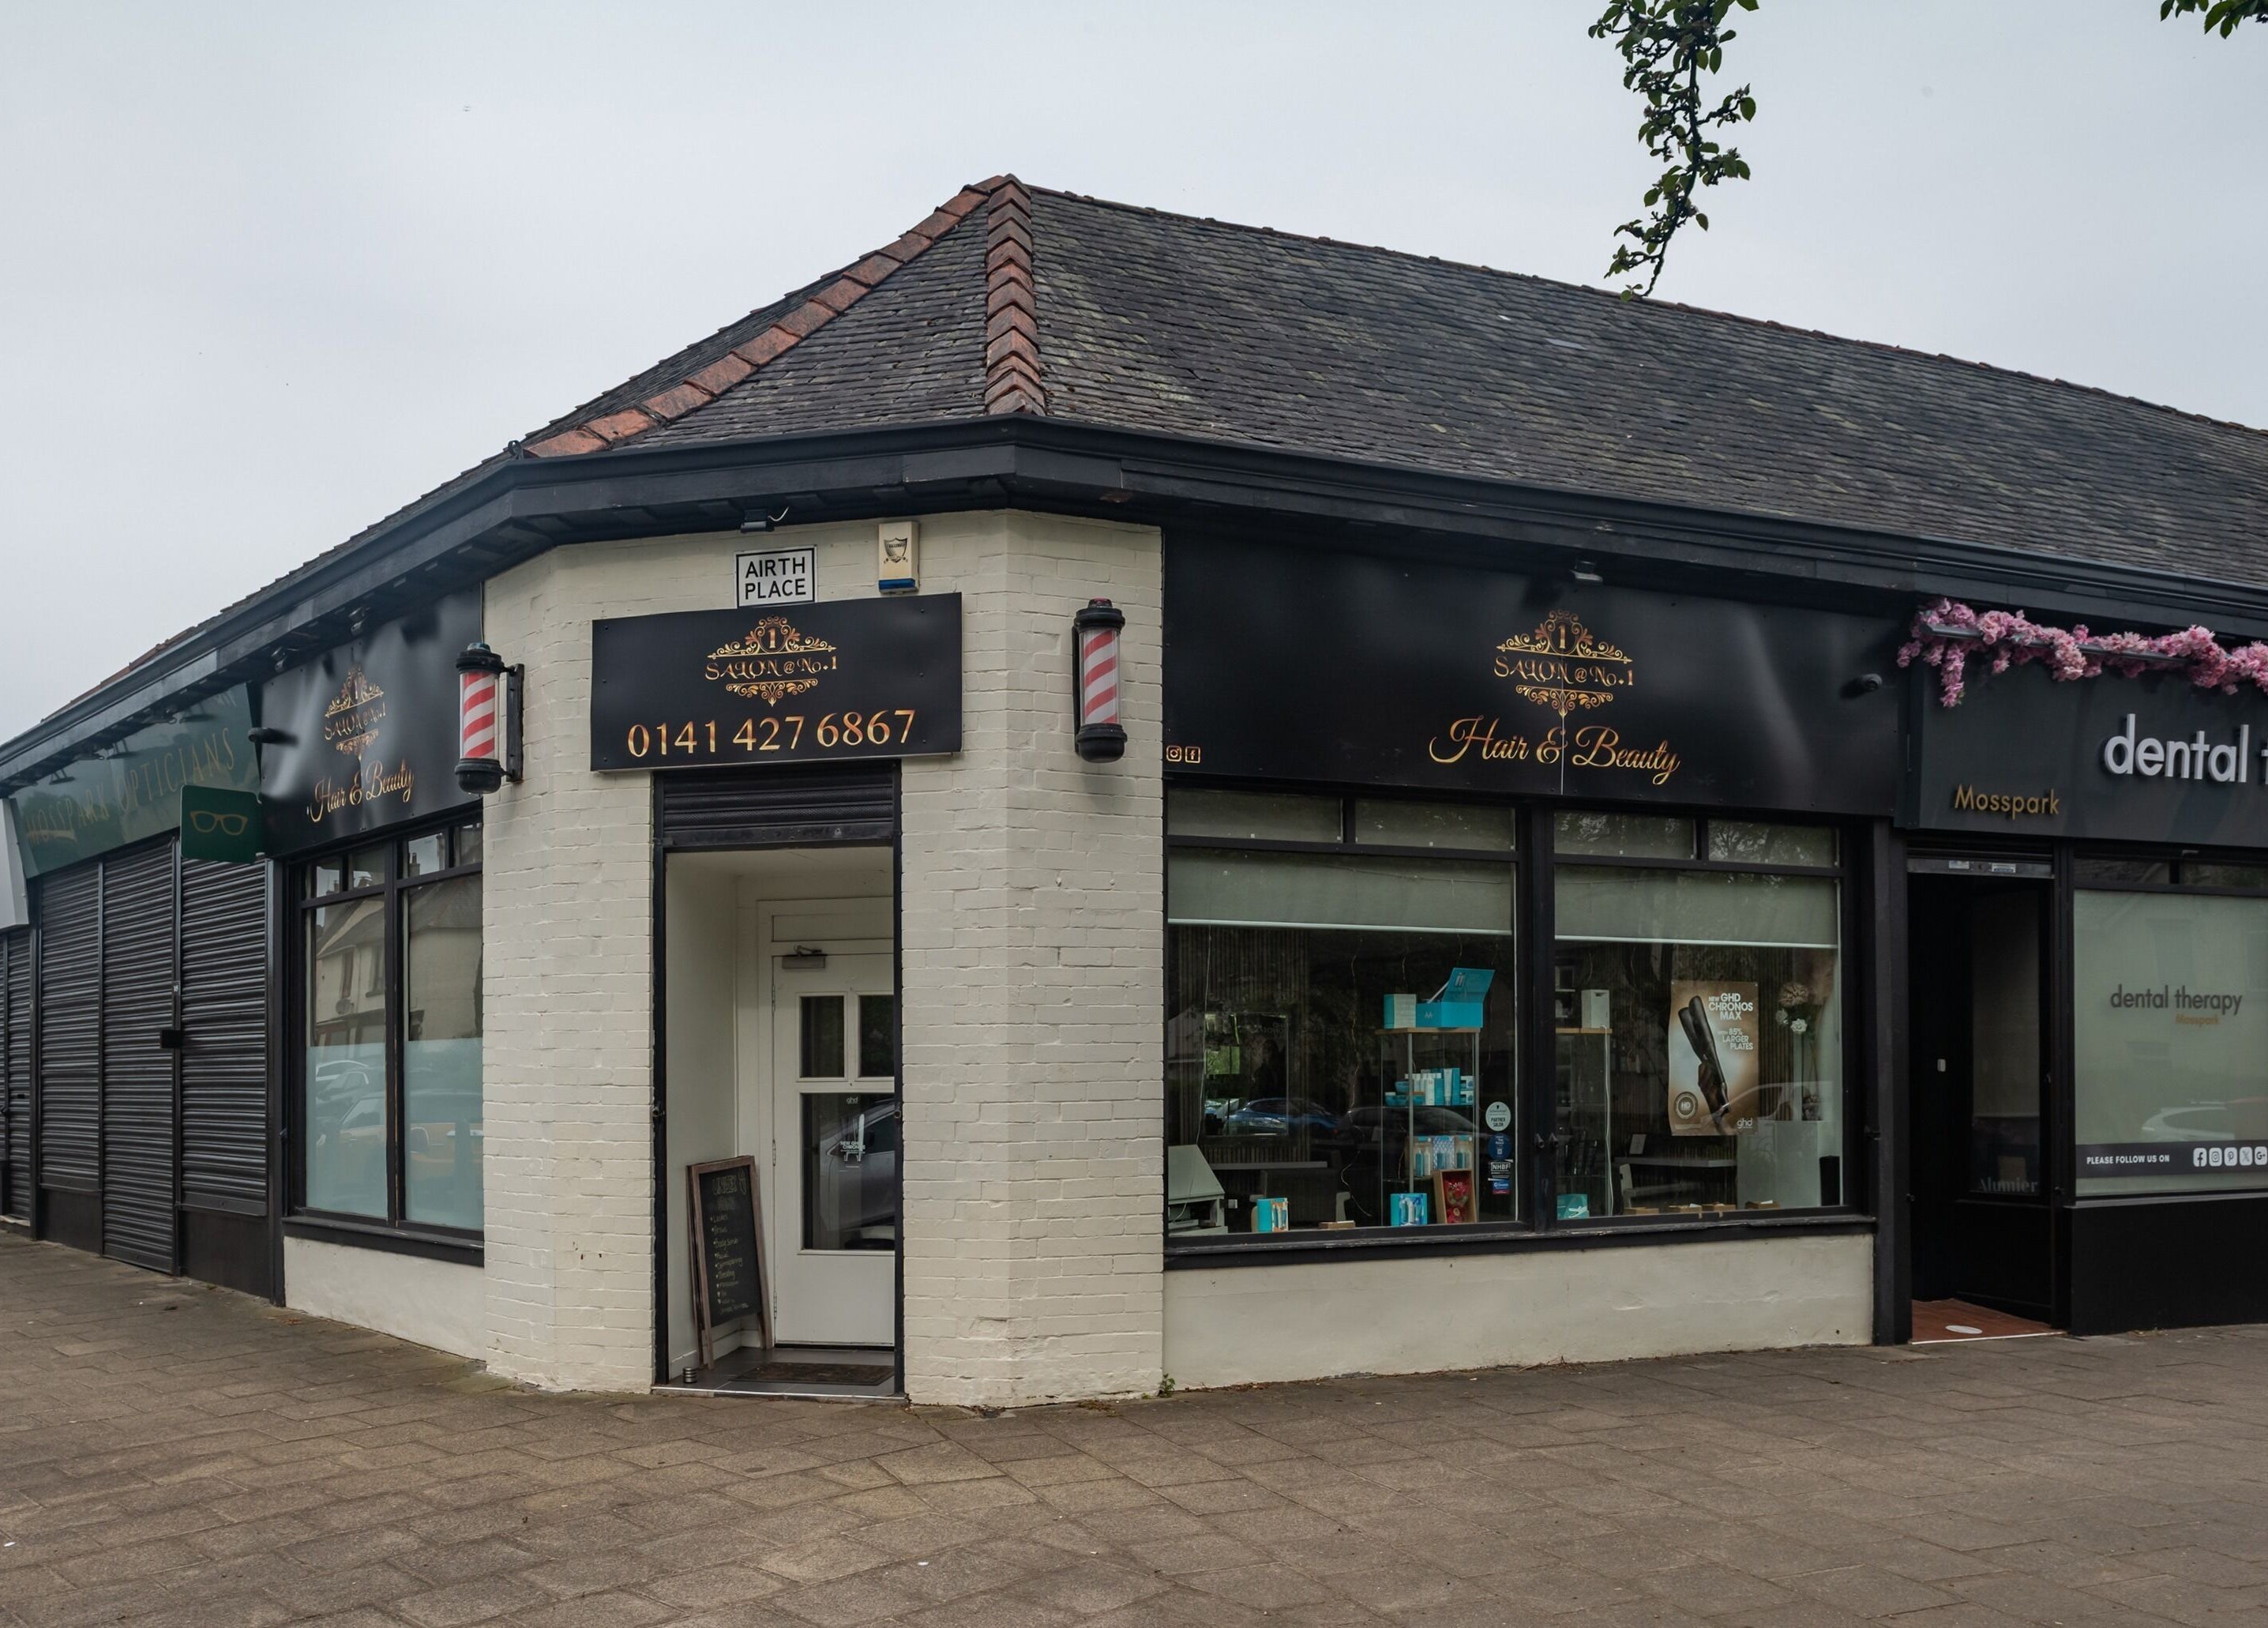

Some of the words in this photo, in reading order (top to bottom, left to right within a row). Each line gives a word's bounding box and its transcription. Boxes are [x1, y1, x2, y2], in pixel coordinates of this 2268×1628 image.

[745, 557, 805, 579] AIRTH
[745, 578, 806, 600] PLACE
[704, 660, 783, 681] SALON
[783, 660, 795, 675] @
[797, 655, 839, 675] No.1
[1493, 655, 1574, 684] SALON
[1575, 667, 1587, 683] @
[1589, 666, 1634, 687] No.1
[627, 720, 715, 758] 0141
[732, 714, 805, 752] 427
[817, 709, 916, 747] 6867
[2103, 712, 2250, 784] dental
[1428, 714, 1530, 765] Hair
[1535, 726, 1568, 765] &
[1571, 725, 1681, 786] Beauty
[115, 727, 235, 812] OPTICIANS
[310, 776, 347, 822] Hair
[365, 758, 415, 803] Beauty
[1954, 784, 2060, 820] Mosspark
[1708, 1002, 1754, 1012] CHRONOS
[1721, 993, 1741, 1002] GHD
[2110, 983, 2168, 1008] dental
[2175, 985, 2243, 1016] therapy
[1720, 1011, 1742, 1020] MAX
[1737, 1117, 1752, 1130] ghd
[2086, 1156, 2114, 1165] PLEASE
[2116, 1155, 2146, 1164] FOLLOW
[2159, 1154, 2170, 1163] ON
